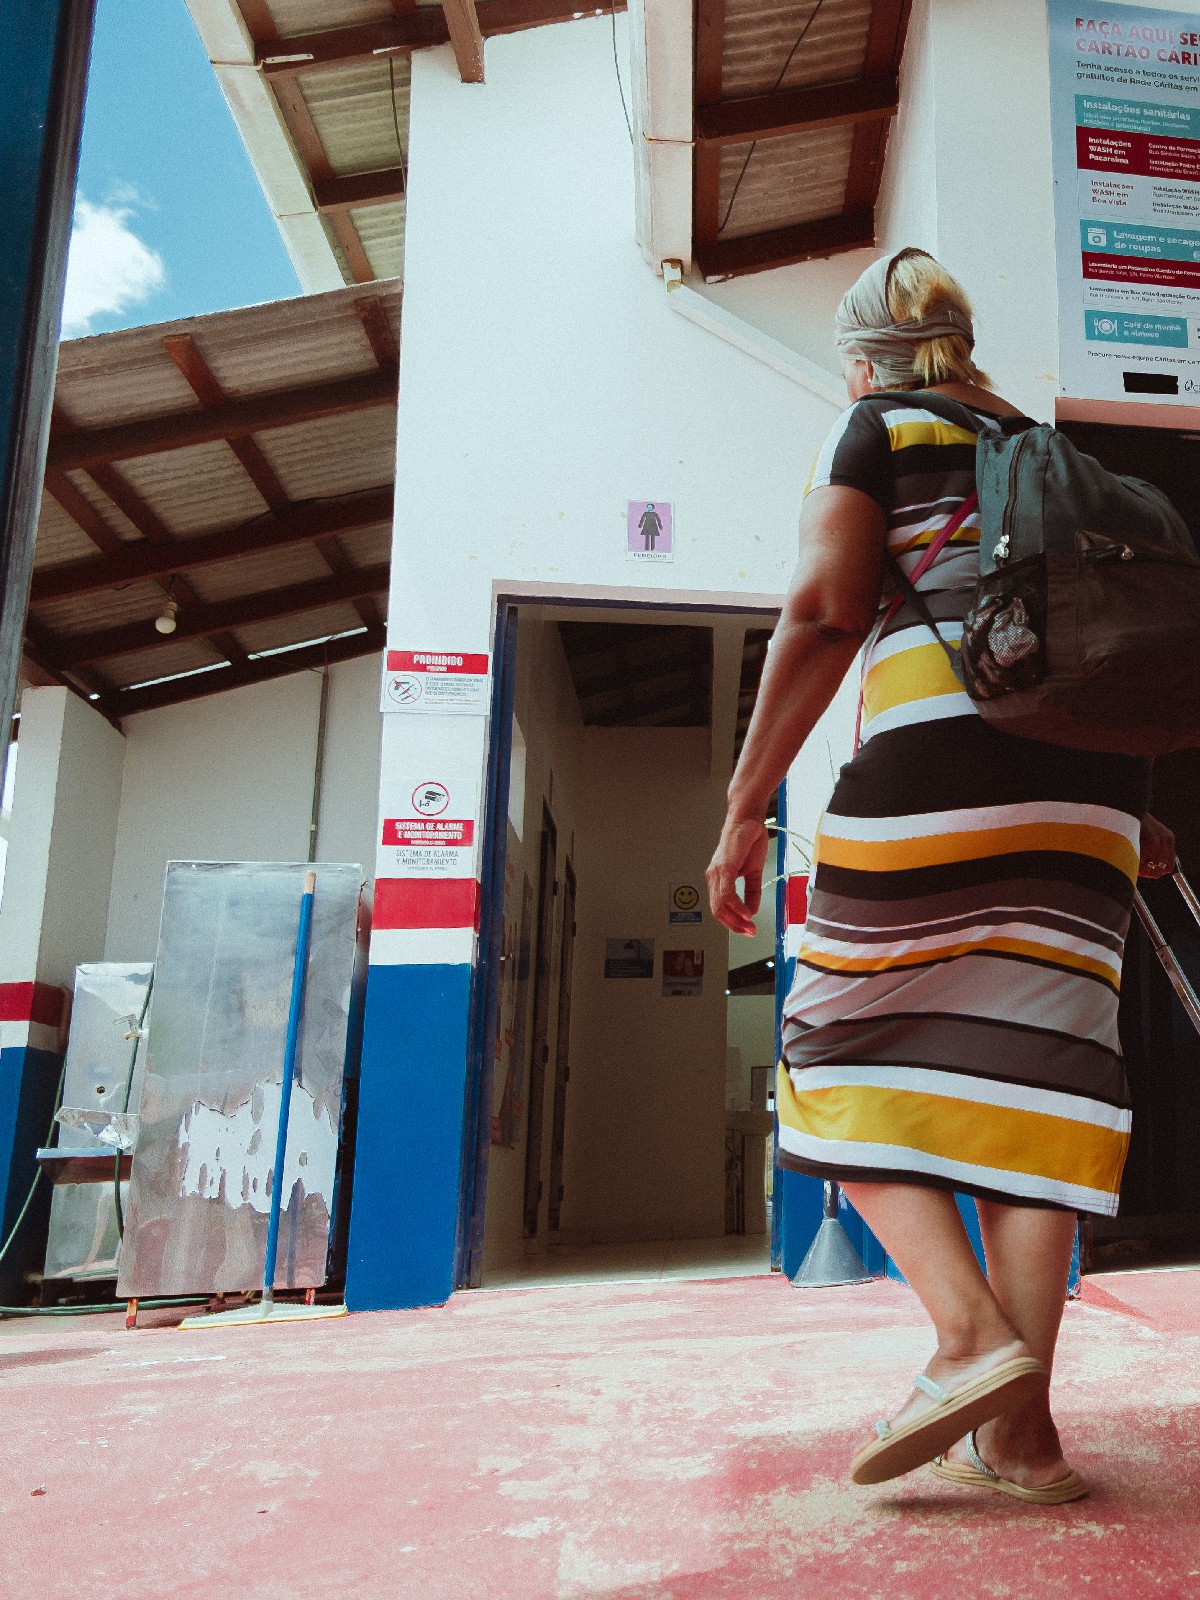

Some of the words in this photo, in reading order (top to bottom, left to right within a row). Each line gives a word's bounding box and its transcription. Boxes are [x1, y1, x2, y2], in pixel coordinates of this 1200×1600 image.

[1075, 17, 1123, 39] FAÇA
[1128, 25, 1175, 44] AQUI
[1075, 37, 1151, 60] CARTÃO
[1076, 60, 1101, 71] Tenha
[1104, 65, 1134, 75] acesso
[1143, 69, 1167, 79] todos
[1076, 71, 1115, 83] gratuitos
[1185, 84, 1198, 92] em
[1083, 99, 1141, 114] Instalações
[1143, 107, 1191, 121] sanitárias
[1088, 137, 1132, 148] Instalações
[1088, 145, 1113, 154] WASH
[1088, 154, 1129, 164] Pacaraima
[1091, 180, 1134, 190] Instalações
[1091, 188, 1115, 197] WASH
[1113, 230, 1157, 242] Lavagem
[1128, 243, 1162, 253] roupas
[1123, 320, 1141, 328] Café
[395, 821, 424, 830] SISTEMA
[436, 822, 464, 831] ALARME
[397, 831, 403, 839] E
[396, 849, 423, 858] SISTEMA
[424, 850, 432, 858] DE
[433, 850, 459, 858] ALARMA
[396, 858, 400, 866] Y
